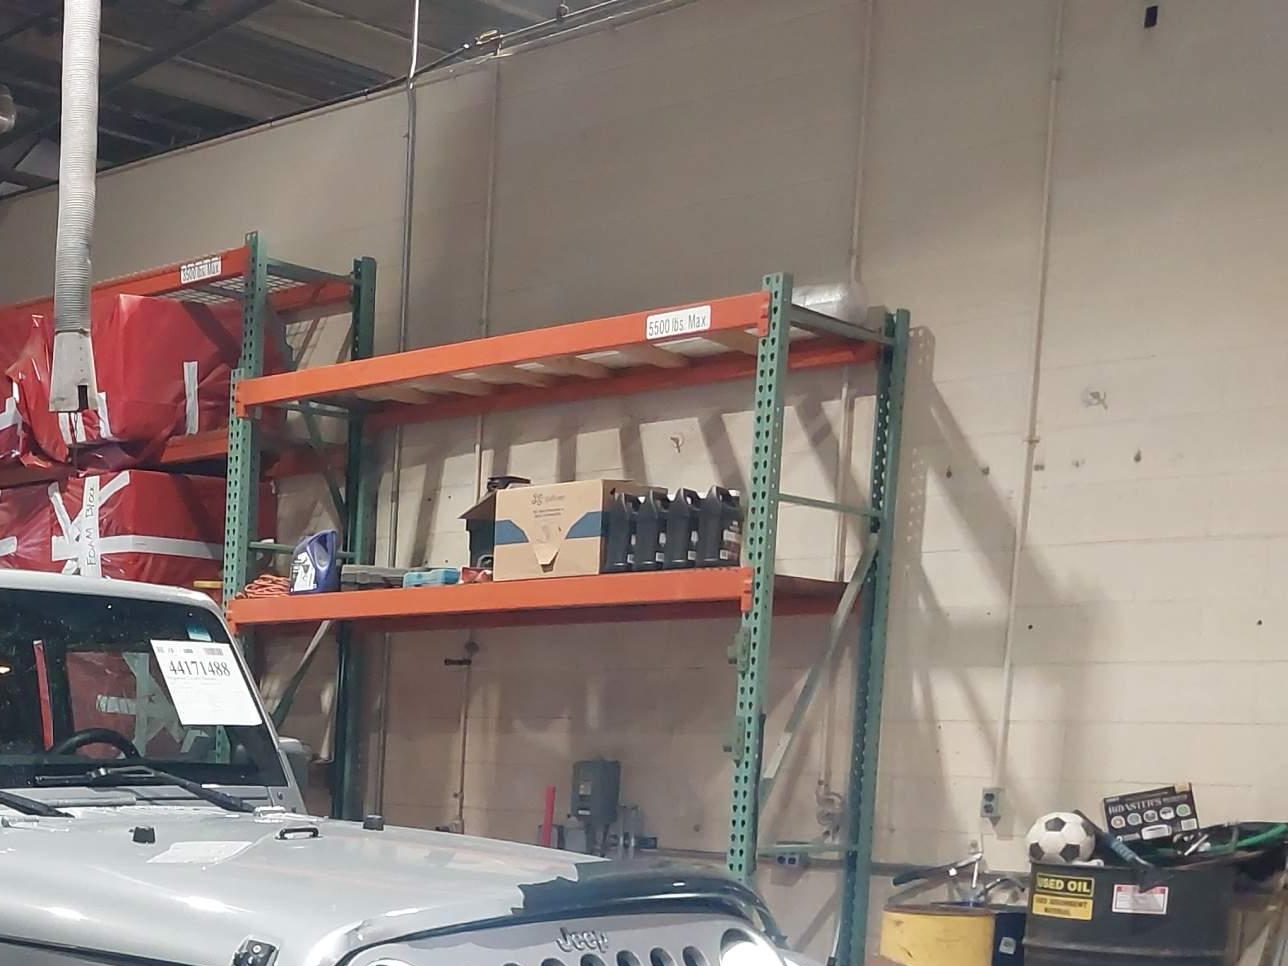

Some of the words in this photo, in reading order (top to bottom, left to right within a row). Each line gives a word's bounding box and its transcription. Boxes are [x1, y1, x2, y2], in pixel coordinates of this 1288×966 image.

[648, 318, 670, 336] 5500
[688, 313, 706, 330] Max
[169, 660, 231, 677] 44171488
[1037, 877, 1065, 890] USED
[1067, 880, 1091, 893] OIL
[555, 926, 609, 954] Jeep
